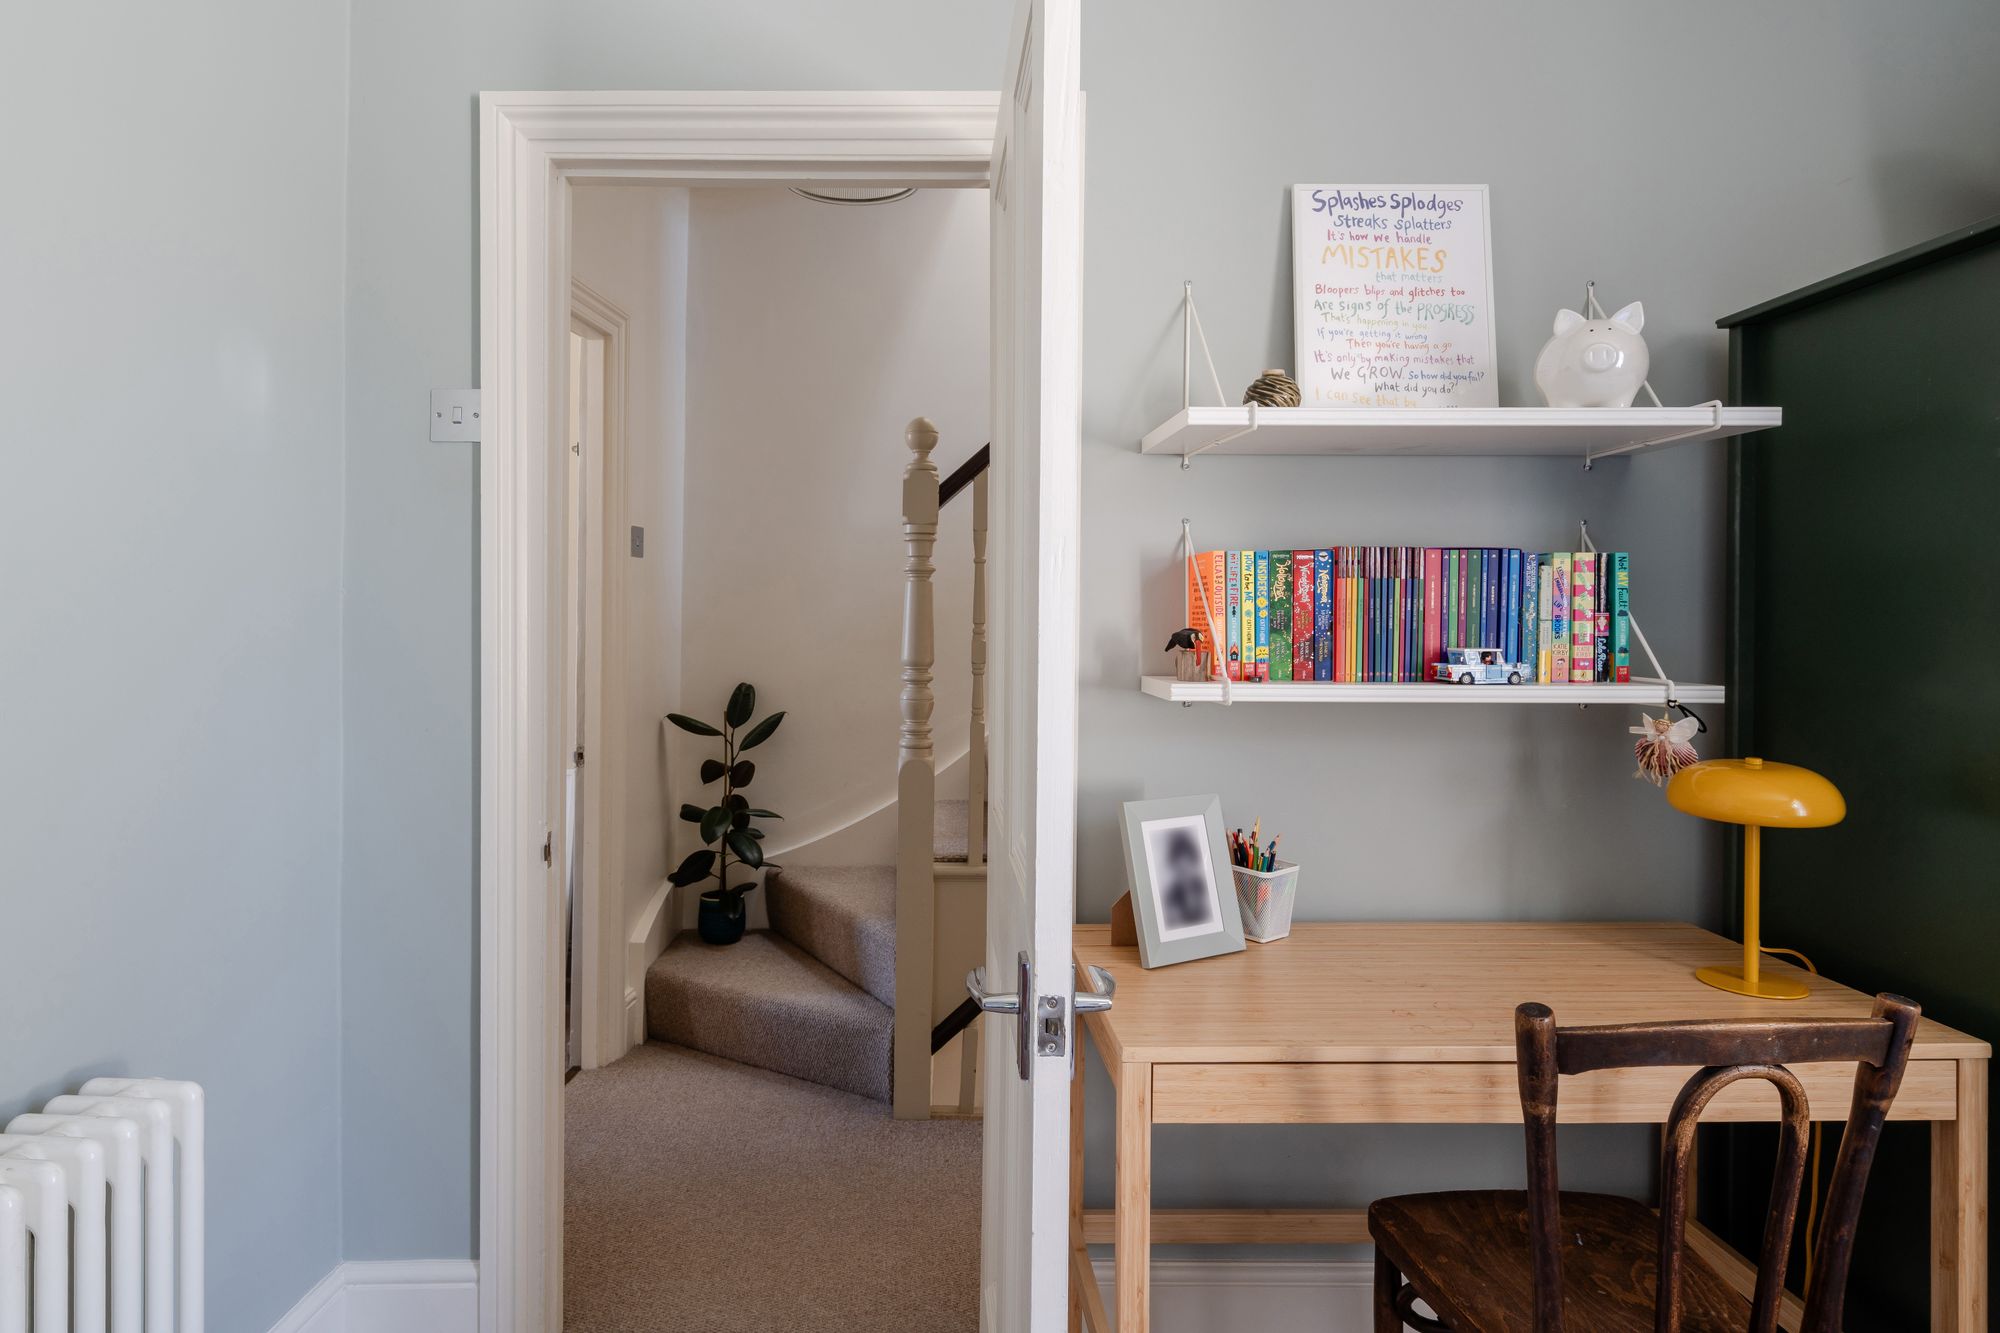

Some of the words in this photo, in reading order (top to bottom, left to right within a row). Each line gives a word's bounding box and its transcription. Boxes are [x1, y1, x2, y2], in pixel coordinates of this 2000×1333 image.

[1312, 190, 1386, 216] Splashes
[1390, 192, 1463, 218] Splodges
[1394, 216, 1452, 235] splatters
[1327, 229, 1345, 241] It's
[1349, 231, 1368, 241] how
[1374, 234, 1389, 243] we
[1396, 232, 1432, 244] handle
[1322, 243, 1447, 273] MISTAKES
[1376, 272, 1397, 282] that
[1401, 272, 1443, 283] matters
[1315, 284, 1359, 296] Bloopers
[1364, 285, 1385, 300] blips
[1390, 288, 1404, 296] and
[1408, 286, 1445, 303] glitches
[1450, 287, 1465, 296] too
[1314, 299, 1334, 311] Are
[1377, 298, 1390, 319] of
[1395, 303, 1412, 315] the
[1417, 303, 1475, 326] PROGRESS
[1321, 312, 1350, 324] That's
[1356, 313, 1398, 329] happening
[1317, 328, 1325, 339] If
[1328, 328, 1354, 341] you're
[1359, 329, 1391, 341] getting
[1405, 333, 1428, 343] wrong
[1346, 338, 1373, 349] Then
[1375, 339, 1400, 354] you're
[1404, 340, 1430, 352] having
[1441, 343, 1453, 353] go
[1314, 350, 1333, 363] It's
[1336, 352, 1356, 368] only
[1360, 353, 1371, 370] by
[1374, 353, 1410, 367] making
[1456, 354, 1475, 365] that
[1331, 367, 1351, 380] We
[1408, 370, 1419, 380] So
[1421, 370, 1438, 381] how
[1440, 371, 1453, 380] did
[1453, 372, 1467, 385] you
[1375, 382, 1400, 392] What
[1404, 382, 1418, 393] did
[1422, 385, 1438, 397] you
[1327, 391, 1347, 401] can
[1376, 393, 1400, 407] that
[1215, 555, 1224, 574] ELLA
[1244, 555, 1254, 572] HOW
[1618, 556, 1628, 571] Not
[1229, 566, 1238, 583] LIFE
[1244, 573, 1253, 581] to
[1258, 560, 1267, 597] INSIDERS
[1617, 572, 1629, 586] MY
[1244, 582, 1254, 591] be
[1215, 586, 1224, 617] OUTSIDE
[1229, 587, 1239, 606] FIRE
[1244, 591, 1254, 603] ME
[1617, 588, 1629, 609] Fault
[1554, 614, 1562, 640] BROOKS
[1597, 638, 1607, 653] Lola
[1597, 652, 1607, 672] Rose
